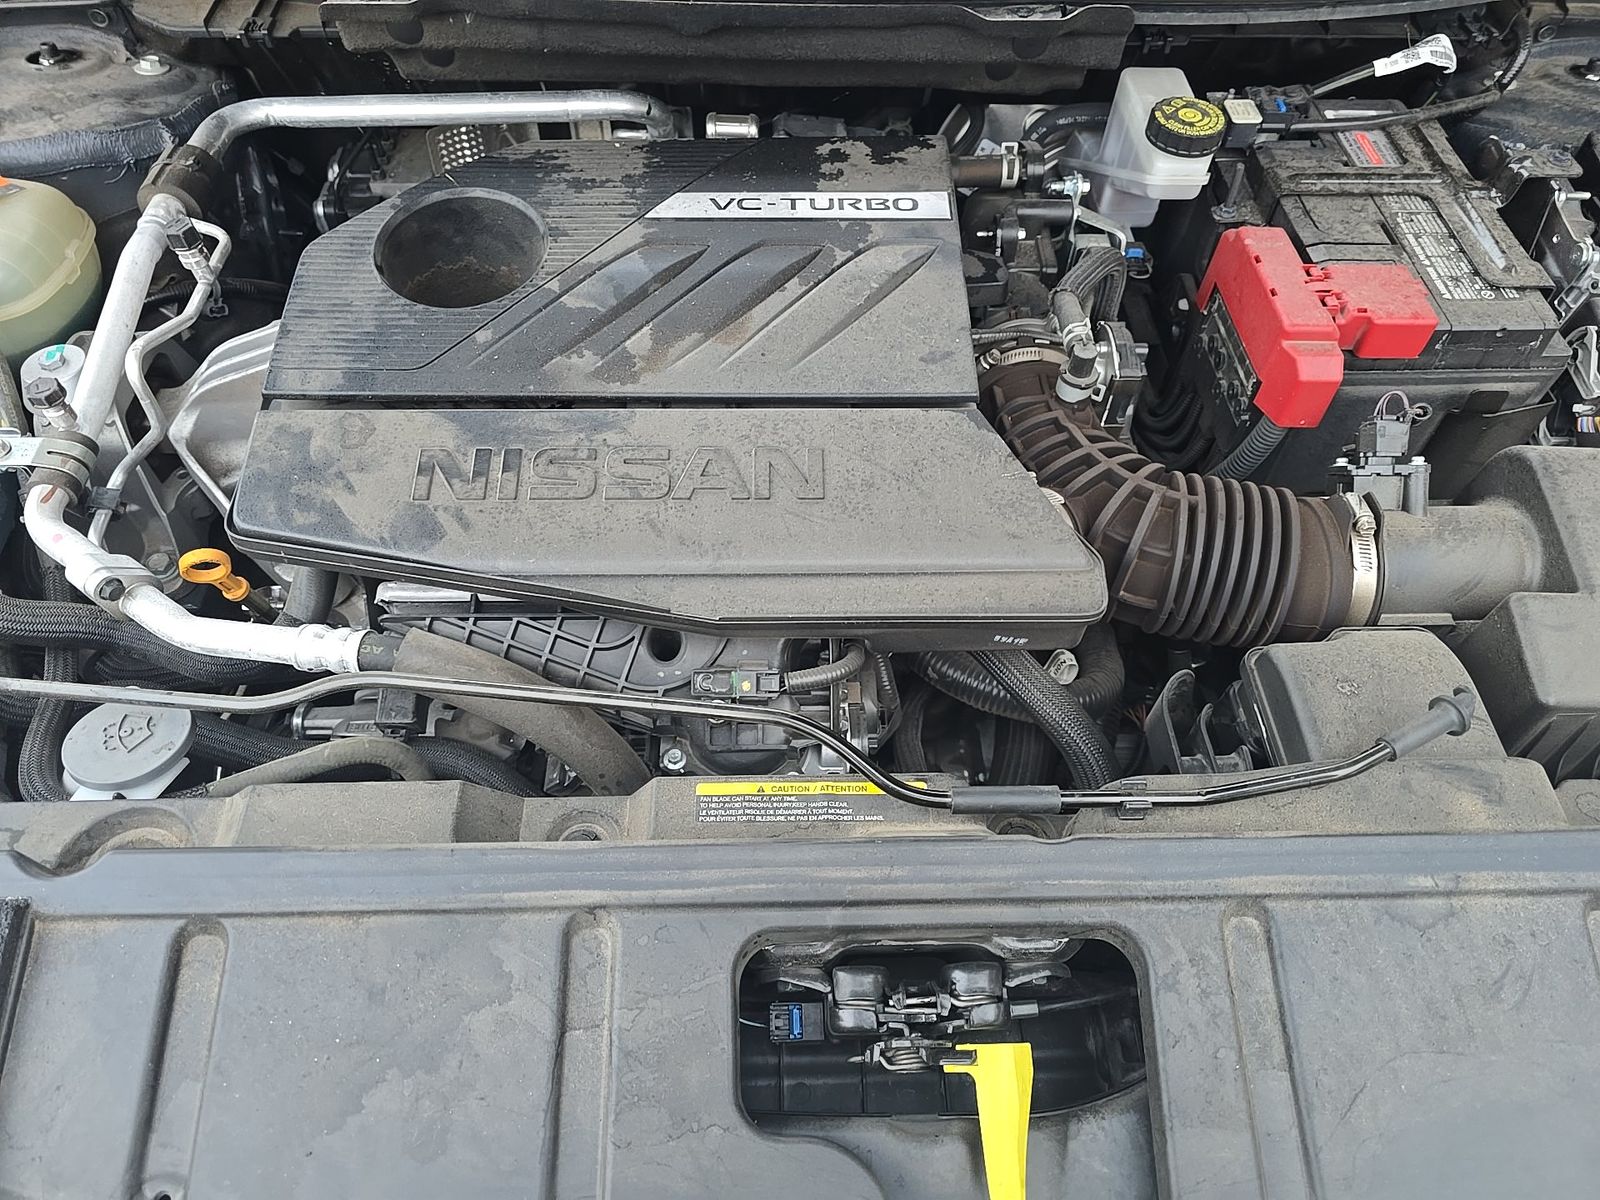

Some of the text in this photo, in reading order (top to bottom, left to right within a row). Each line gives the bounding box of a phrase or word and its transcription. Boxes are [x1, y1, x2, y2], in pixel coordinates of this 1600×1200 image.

[709, 197, 919, 212] VC-TURBO
[410, 446, 826, 501] NISSAN
[820, 784, 868, 792] ATTENTION
